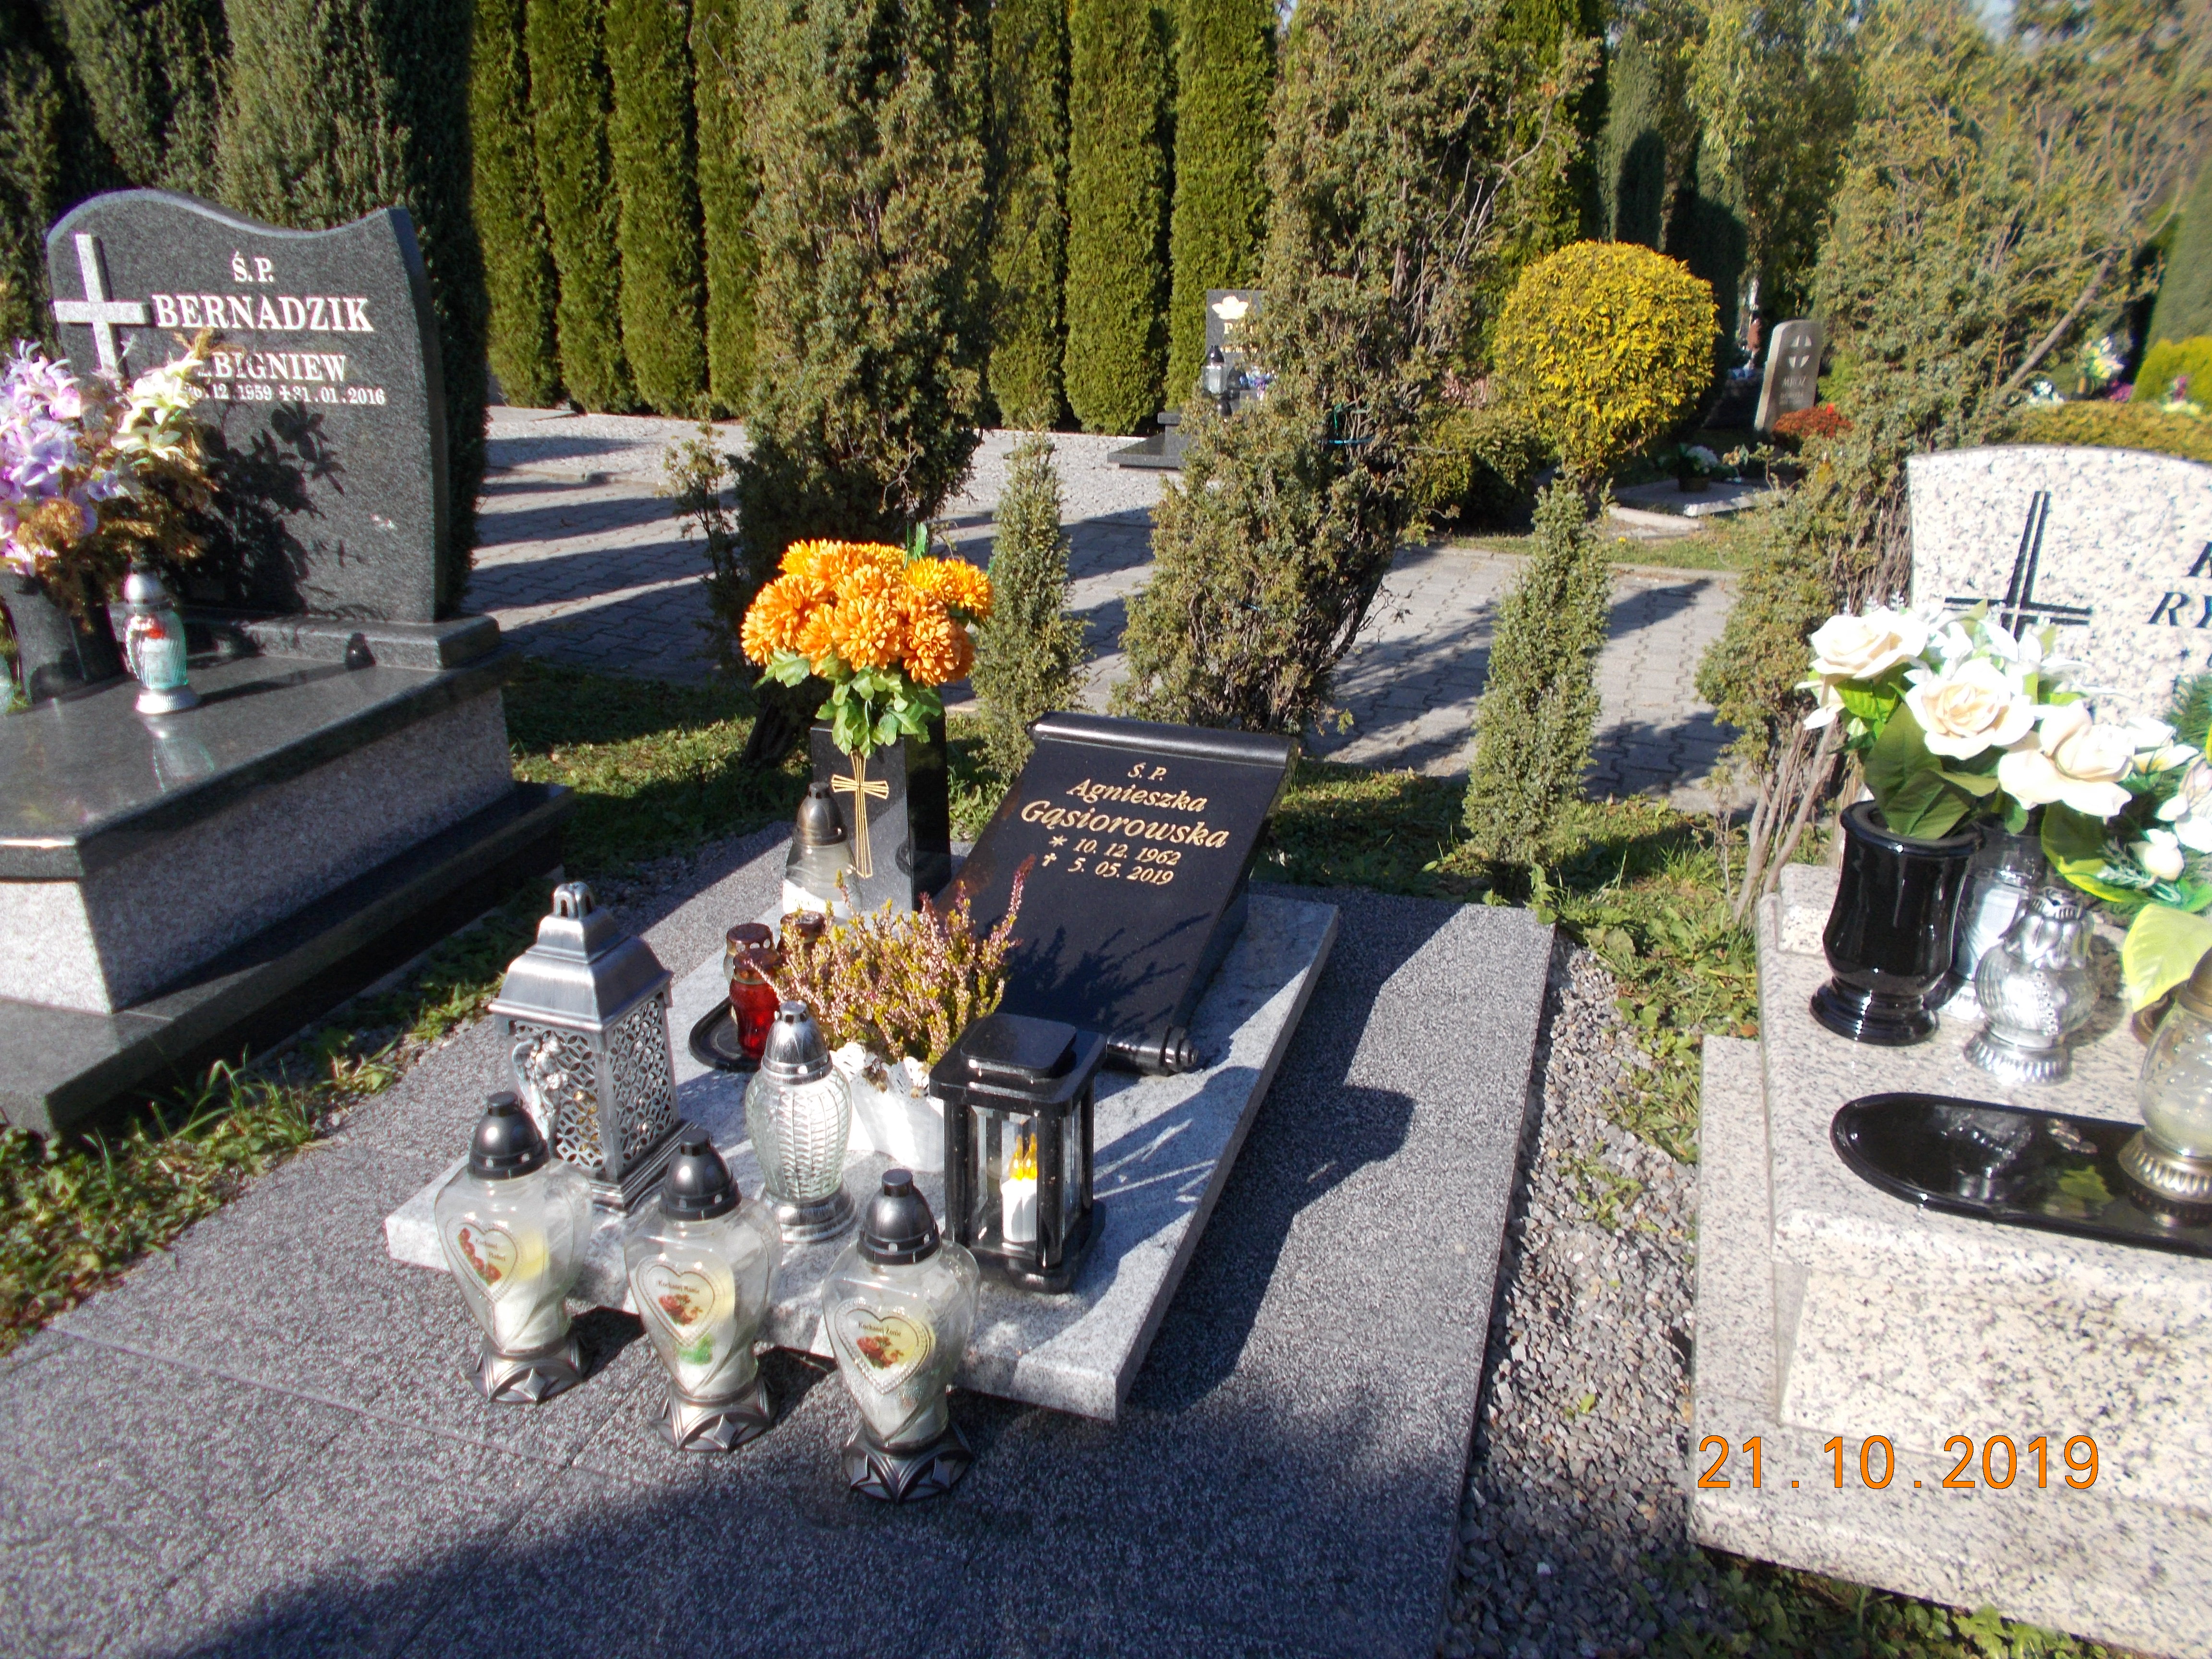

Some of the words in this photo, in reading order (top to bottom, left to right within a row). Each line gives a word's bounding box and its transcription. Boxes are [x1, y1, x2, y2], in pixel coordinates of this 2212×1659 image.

[152, 293, 373, 332] BERNADZIK
[1066, 778, 1207, 813] Agnieszka
[1021, 800, 1229, 848] Gąsiorowska
[1134, 847, 1181, 866] 1962
[1126, 866, 1175, 885] 2019
[858, 1321, 884, 1335] Kochanej
